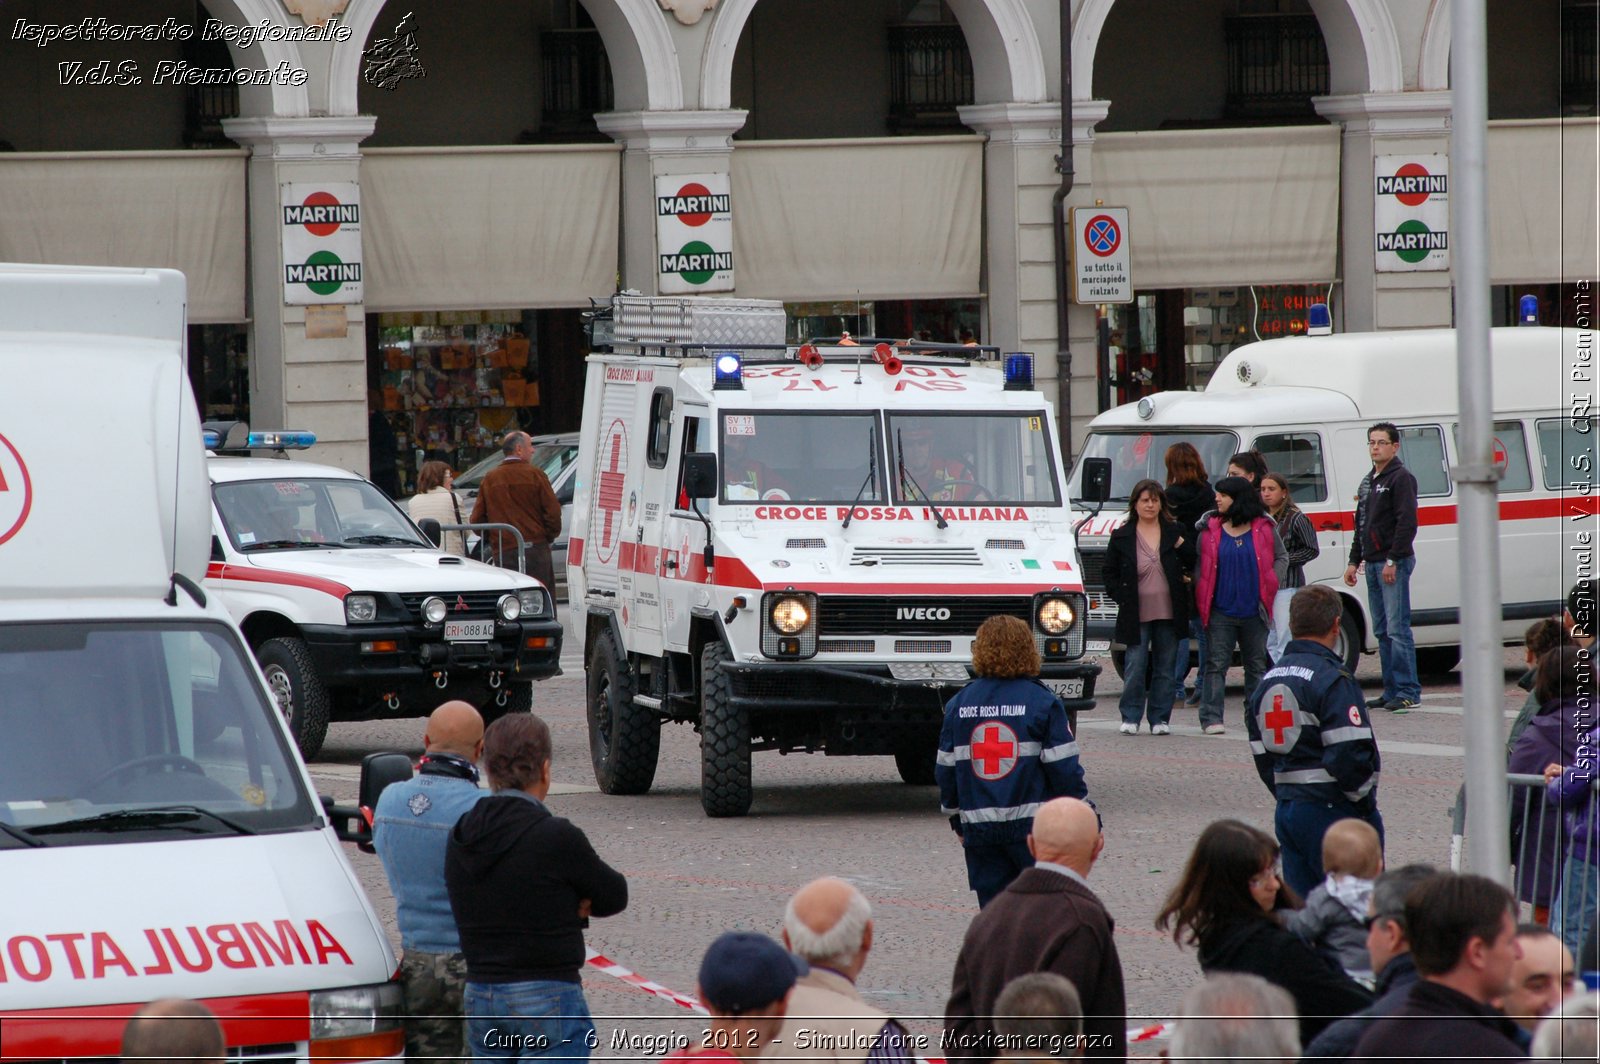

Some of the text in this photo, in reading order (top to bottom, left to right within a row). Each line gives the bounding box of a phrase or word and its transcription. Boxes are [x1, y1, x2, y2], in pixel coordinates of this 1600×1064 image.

[1379, 176, 1446, 193] MARTINI
[660, 196, 729, 214] MARTINI
[285, 205, 358, 223] MARTINI
[1379, 233, 1446, 250] MARTINI
[662, 253, 731, 272] MARTINI
[1095, 263, 1115, 272] tutto
[1116, 262, 1122, 271] il
[287, 264, 360, 282] MARTINI
[1082, 275, 1126, 285] marciapiede
[1090, 287, 1119, 295] rialzato
[727, 416, 752, 424] SV 17
[728, 426, 738, 434] 10
[745, 426, 754, 434] 23
[754, 506, 1030, 521] CROCE ROSSA ITALIANA
[896, 607, 951, 621] IVECO
[1046, 683, 1082, 695] 125C
[959, 704, 1026, 718] CROCE ROSSA ITALIANA
